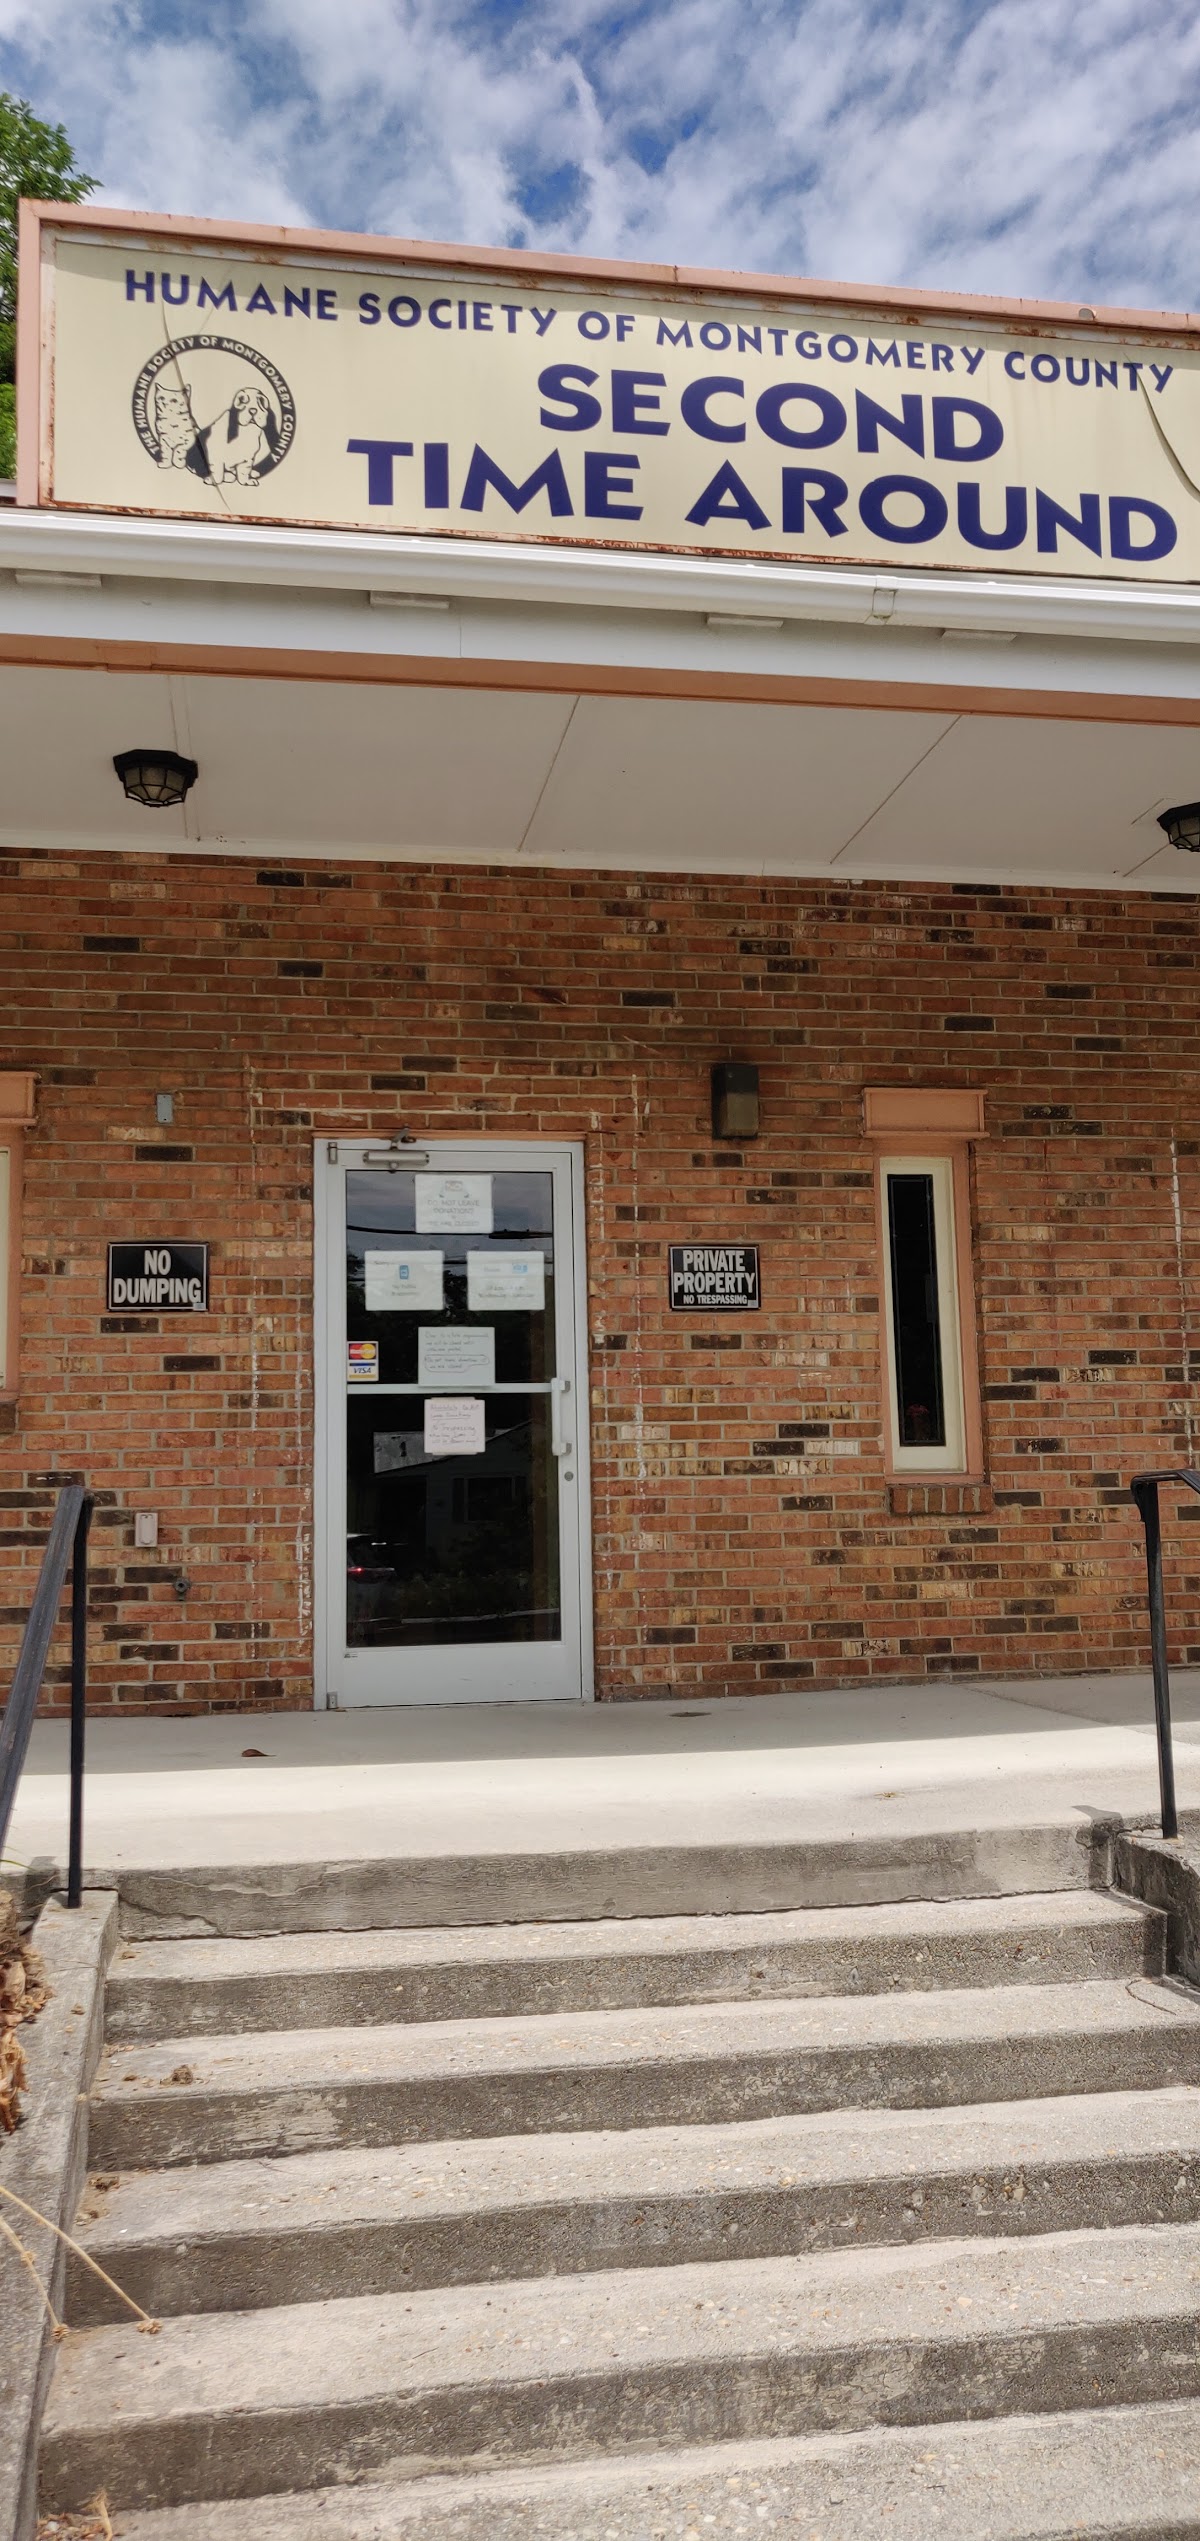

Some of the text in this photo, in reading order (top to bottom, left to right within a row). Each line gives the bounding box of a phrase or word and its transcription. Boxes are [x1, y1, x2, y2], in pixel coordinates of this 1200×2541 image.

[125, 269, 1175, 394] HUMANE SOCIETY OF MONTGOMERY COUNTY
[133, 335, 295, 463] THE HUMANE SOCIETY OF MONTGOMERY COUNTY
[537, 363, 1005, 463] SECOND
[346, 438, 1179, 562] TIME AROUND
[144, 1249, 172, 1275] NO
[682, 1249, 746, 1272] PRIVATE
[113, 1277, 202, 1304] DUMPING
[673, 1271, 756, 1293] PROPERTY
[683, 1294, 748, 1305] NO TRESPASSING
[353, 1366, 372, 1374] VISA
